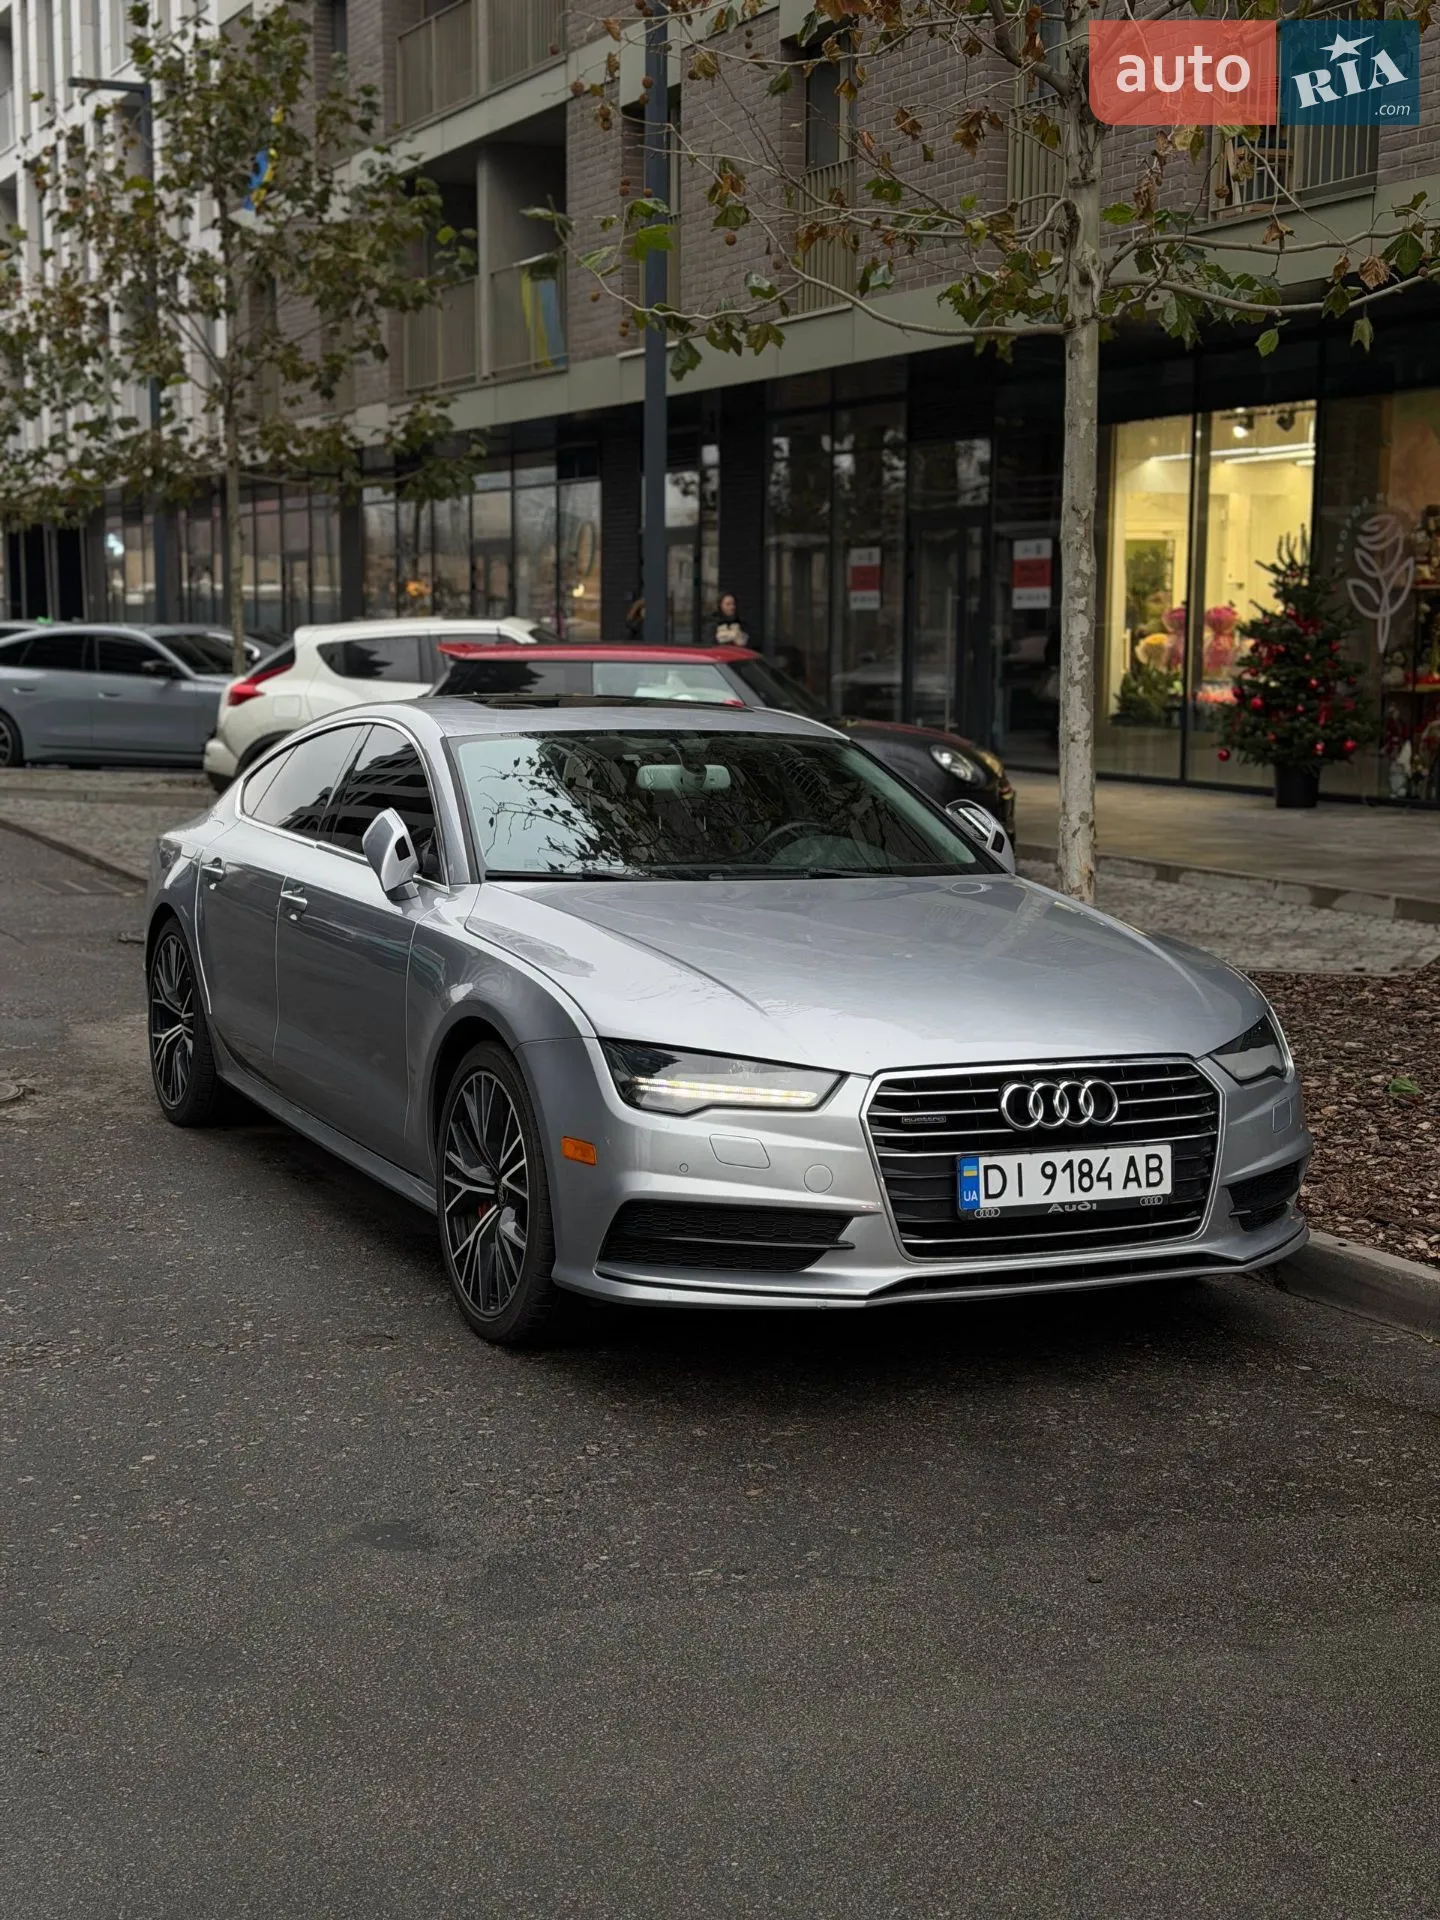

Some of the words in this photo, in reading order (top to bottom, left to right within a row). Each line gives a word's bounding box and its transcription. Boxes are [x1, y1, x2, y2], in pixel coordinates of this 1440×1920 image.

[983, 1162, 1024, 1200] DI
[1040, 1156, 1113, 1196] 9184
[1122, 1153, 1164, 1190] AB
[963, 1190, 978, 1202] UA
[1048, 1201, 1097, 1214] Audi
